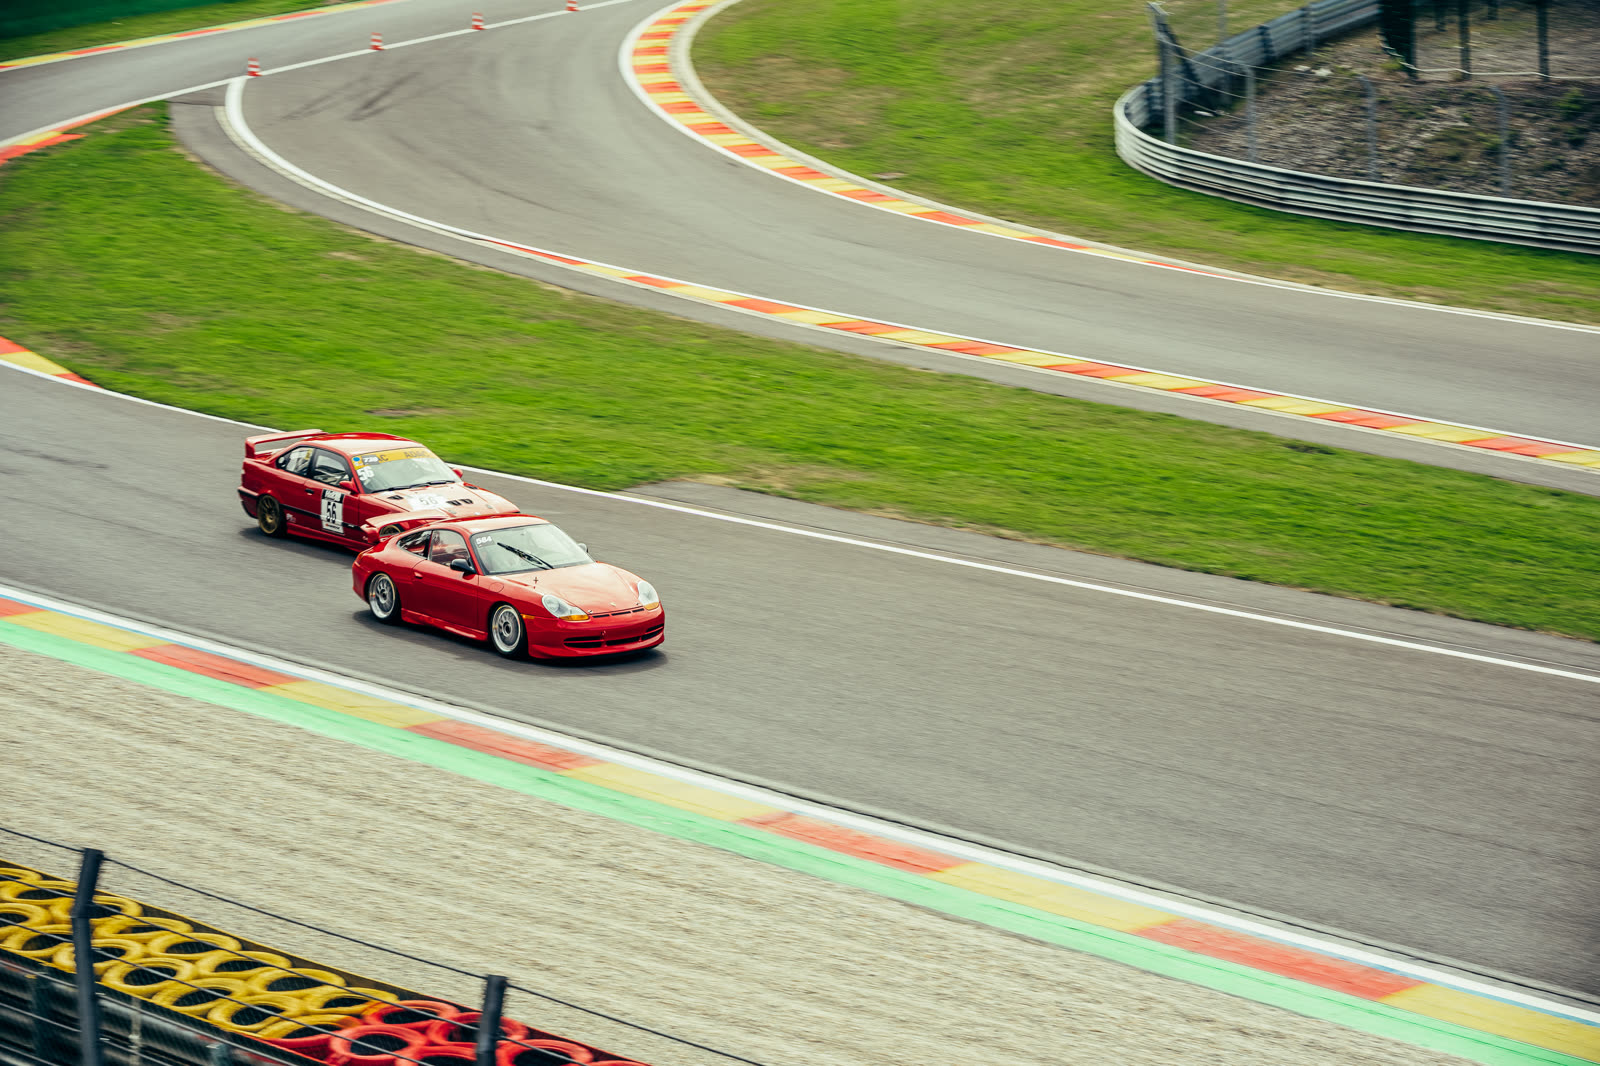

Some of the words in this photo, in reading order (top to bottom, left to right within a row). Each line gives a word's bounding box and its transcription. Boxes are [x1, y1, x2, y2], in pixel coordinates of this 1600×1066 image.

[357, 465, 375, 481] 56
[418, 497, 439, 506] 56
[326, 501, 336, 524] 56
